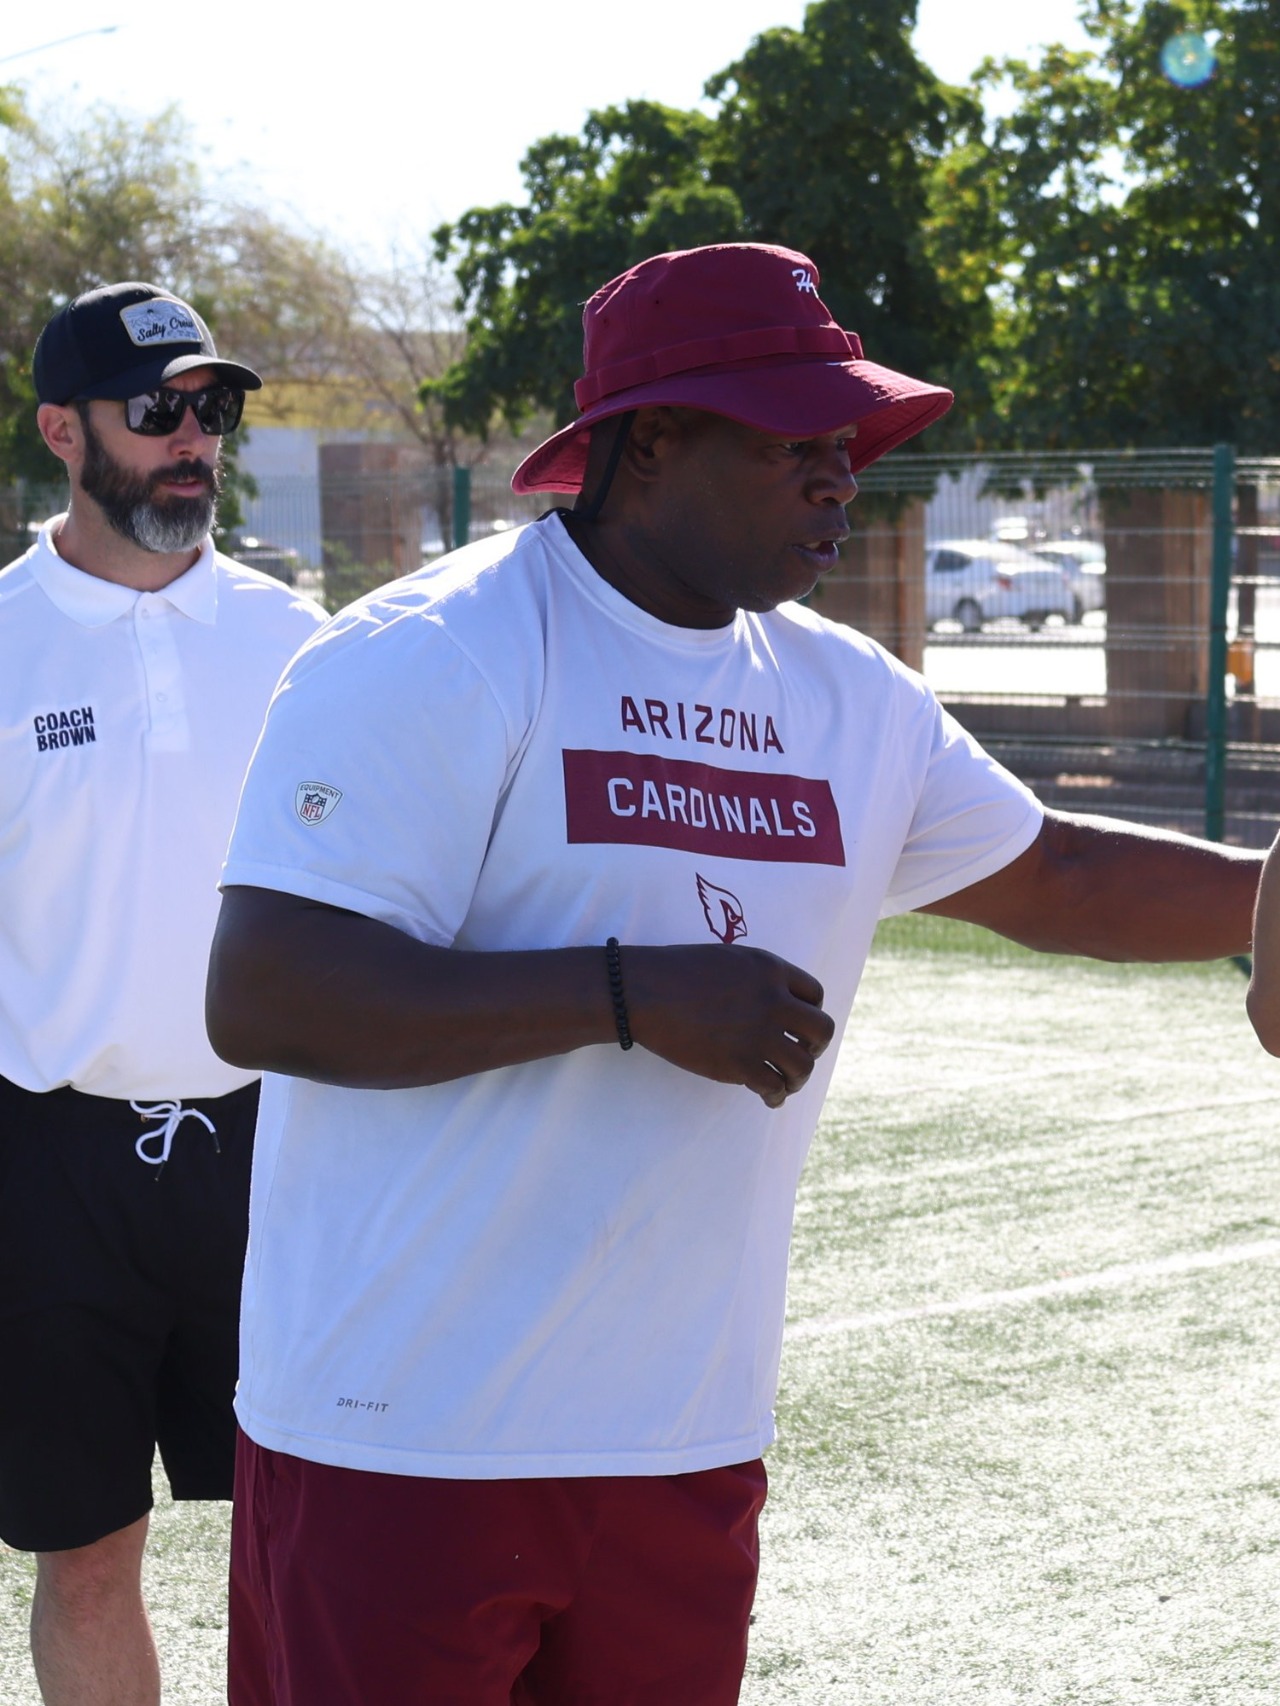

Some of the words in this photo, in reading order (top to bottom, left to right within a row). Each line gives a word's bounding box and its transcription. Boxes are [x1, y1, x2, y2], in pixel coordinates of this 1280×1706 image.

[137, 323, 166, 342] Salty
[34, 706, 94, 734] COACH
[621, 696, 785, 754] ARIZONA
[36, 725, 96, 752] BROWN
[300, 784, 339, 799] EQUIPMENT
[303, 803, 321, 818] NFL
[606, 777, 817, 838] CARDINALS
[336, 1397, 389, 1412] DRI-FIT
